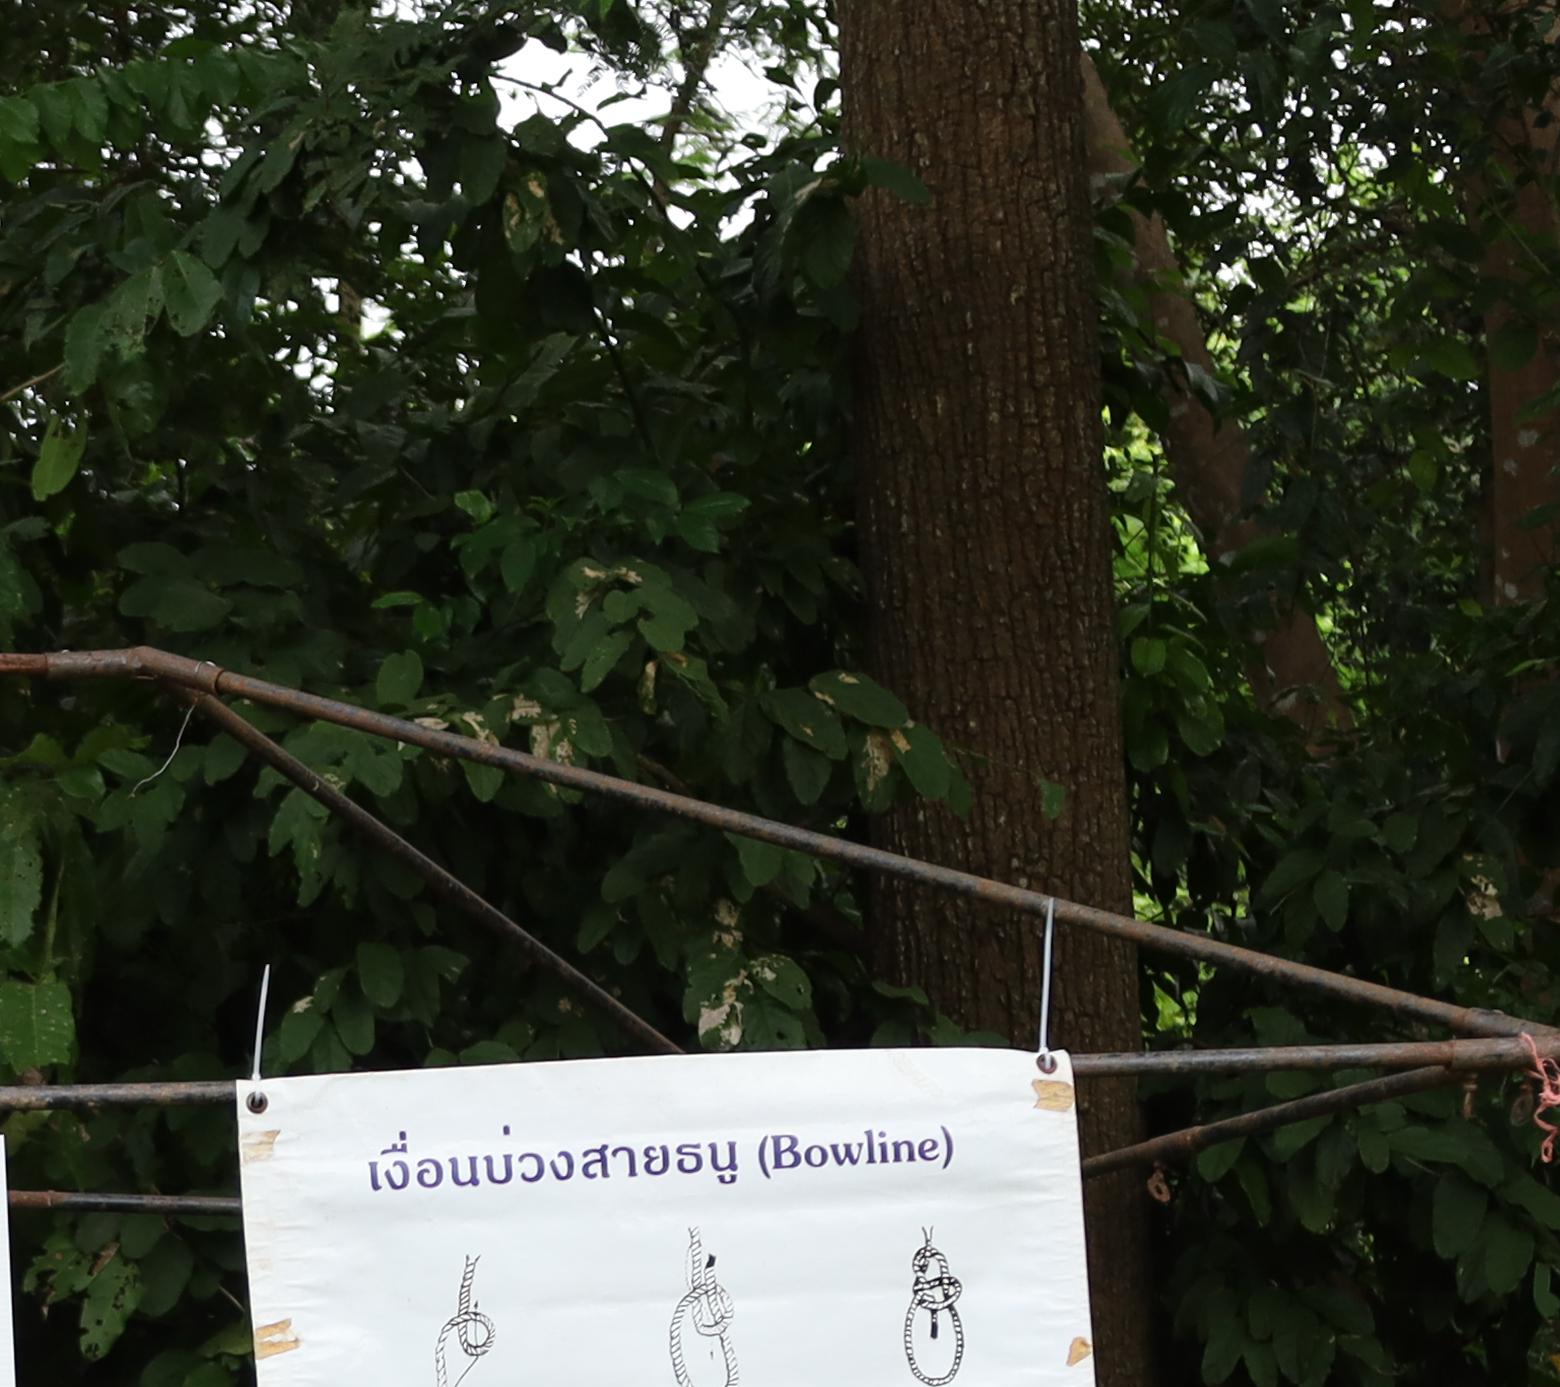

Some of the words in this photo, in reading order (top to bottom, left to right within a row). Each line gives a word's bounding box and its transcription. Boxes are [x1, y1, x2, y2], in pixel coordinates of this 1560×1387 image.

[367, 1124, 739, 1193] เงื่อนบ่วงสายธนู
[756, 1125, 955, 1179] (Bowline)
